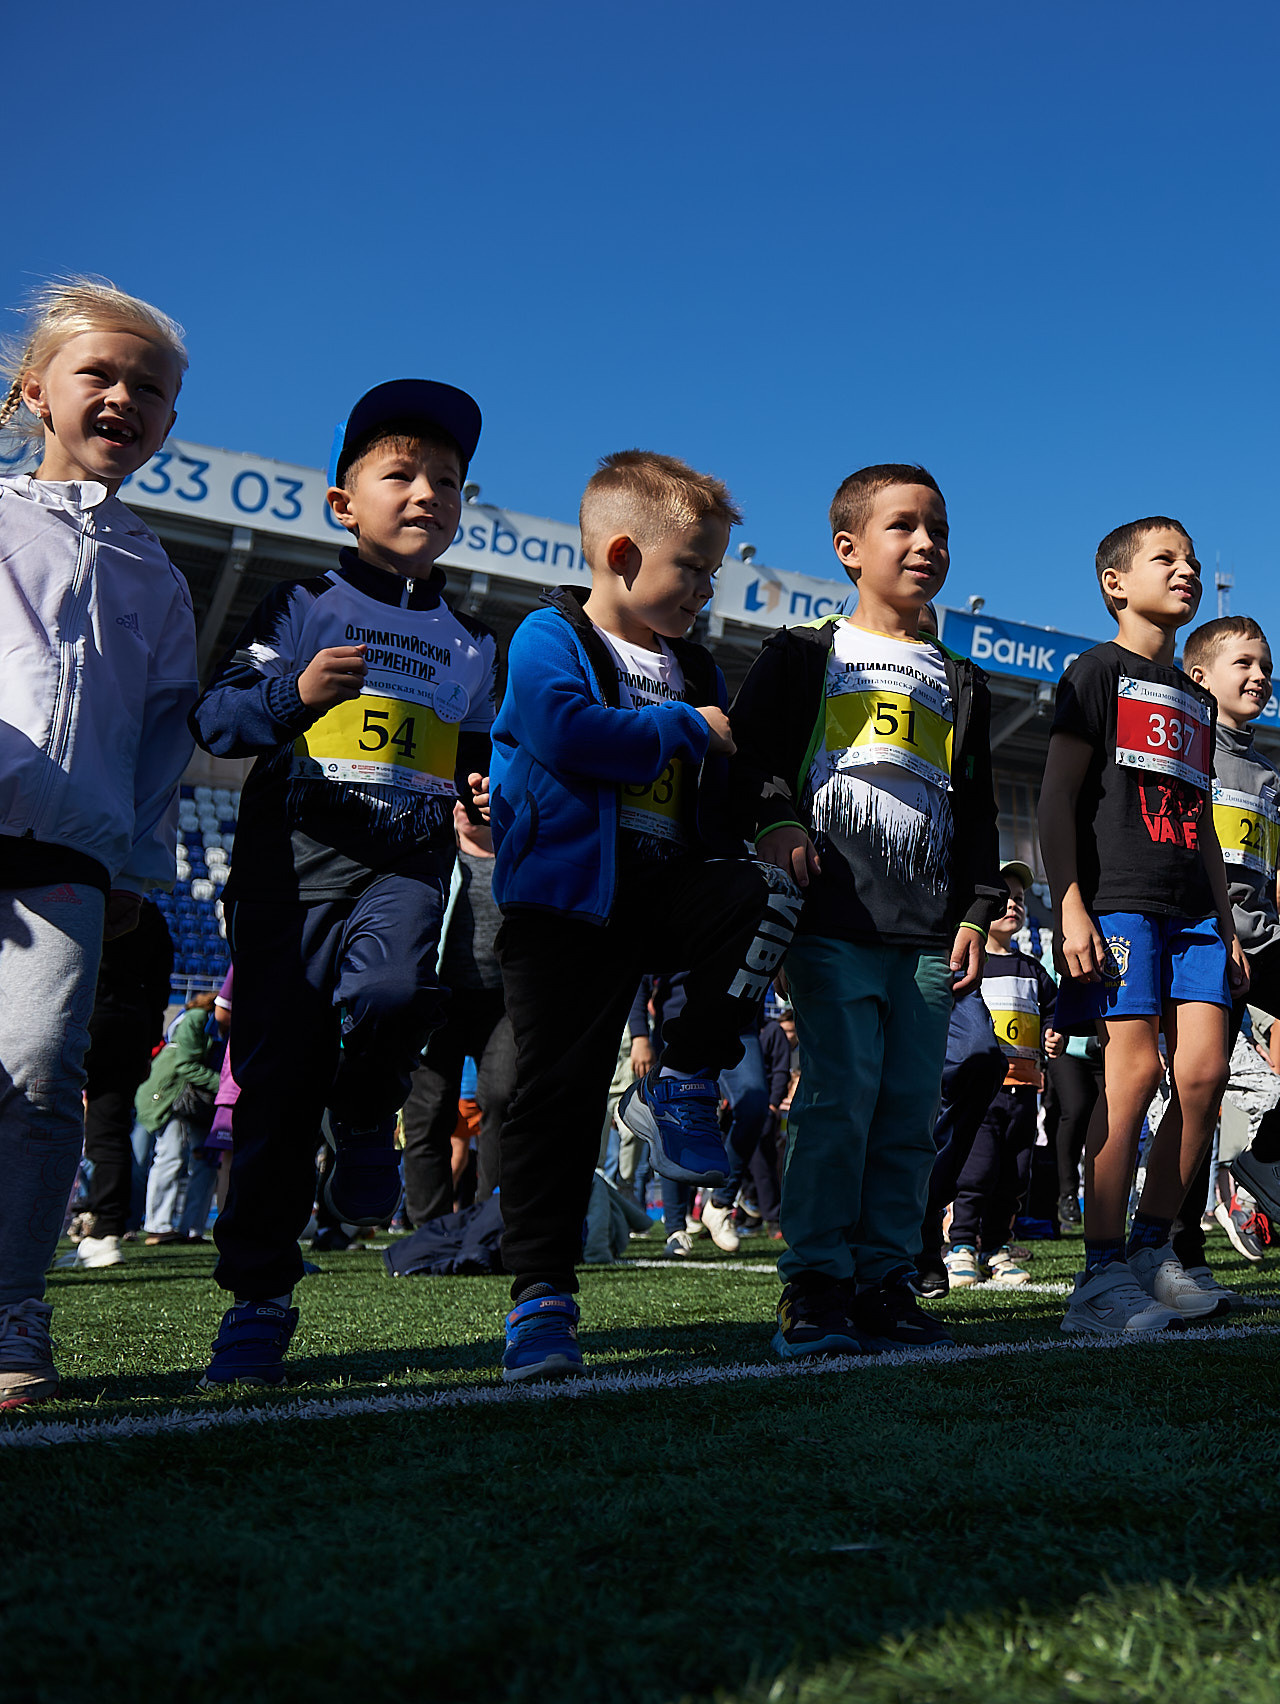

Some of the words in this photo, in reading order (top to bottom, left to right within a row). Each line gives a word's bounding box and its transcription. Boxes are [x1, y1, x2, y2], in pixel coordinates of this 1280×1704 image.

[120, 451, 209, 502] 33
[231, 470, 304, 521] 03
[789, 591, 843, 619] ПС
[345, 623, 451, 668] ОЛИМПИЙСКИЙ
[364, 648, 436, 682] ОРИЕНТИР
[971, 625, 1056, 673] Банк
[358, 709, 417, 759] 54
[874, 702, 918, 747] 51
[1146, 713, 1195, 756] 337
[1240, 818, 1264, 852] 22
[727, 893, 805, 1002] VIBE
[1006, 1018, 1019, 1040] 6
